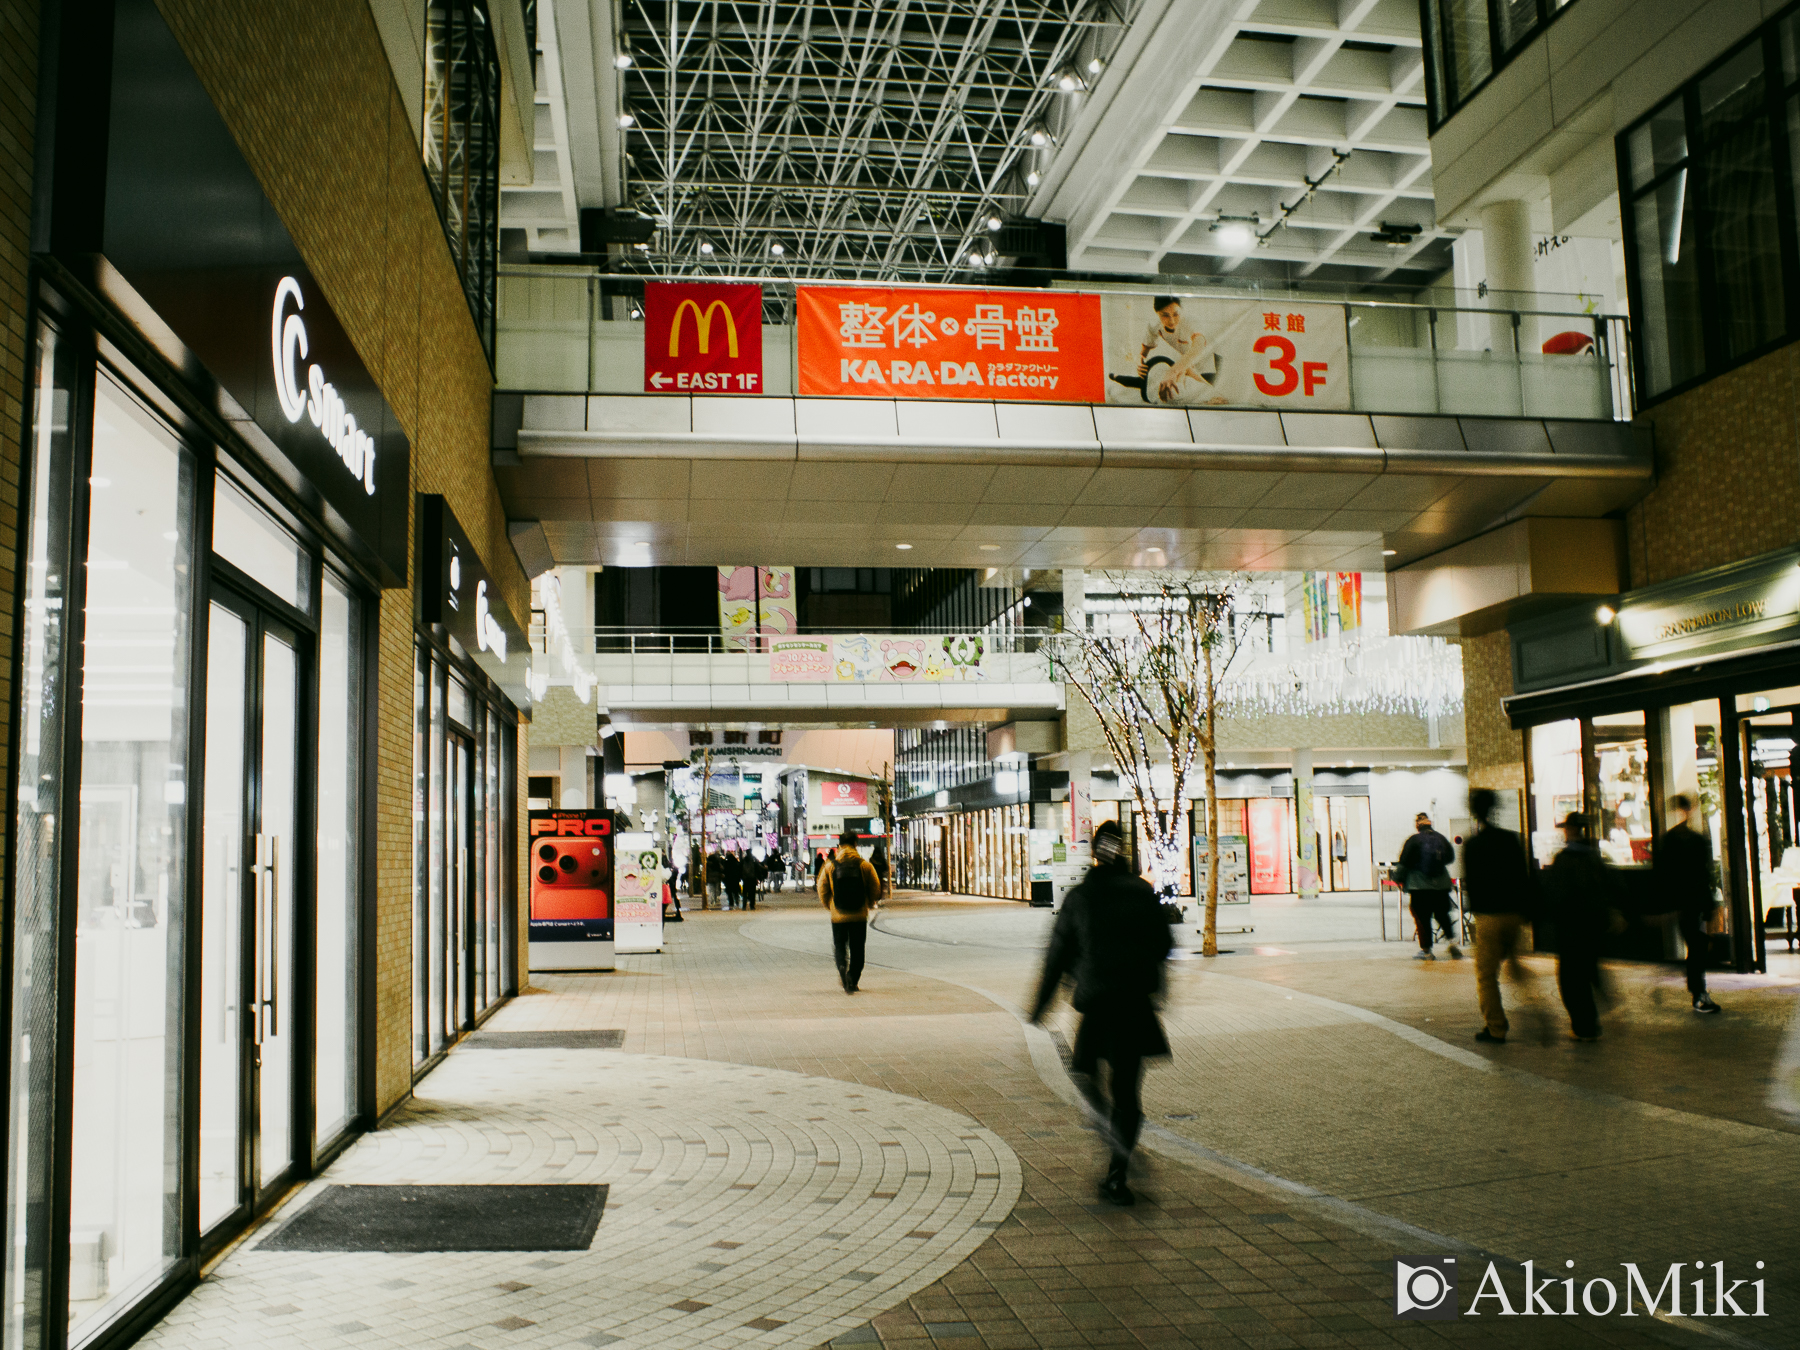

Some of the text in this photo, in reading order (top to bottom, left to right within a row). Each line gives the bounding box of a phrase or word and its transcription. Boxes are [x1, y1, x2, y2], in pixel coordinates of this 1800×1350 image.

[1262, 312, 1306, 334] 東館
[987, 362, 1059, 373] カラダファクトリー
[1253, 335, 1328, 397] 3F
[677, 372, 759, 390] EAST 1F
[987, 371, 1060, 390] factory
[530, 818, 611, 836] PRO
